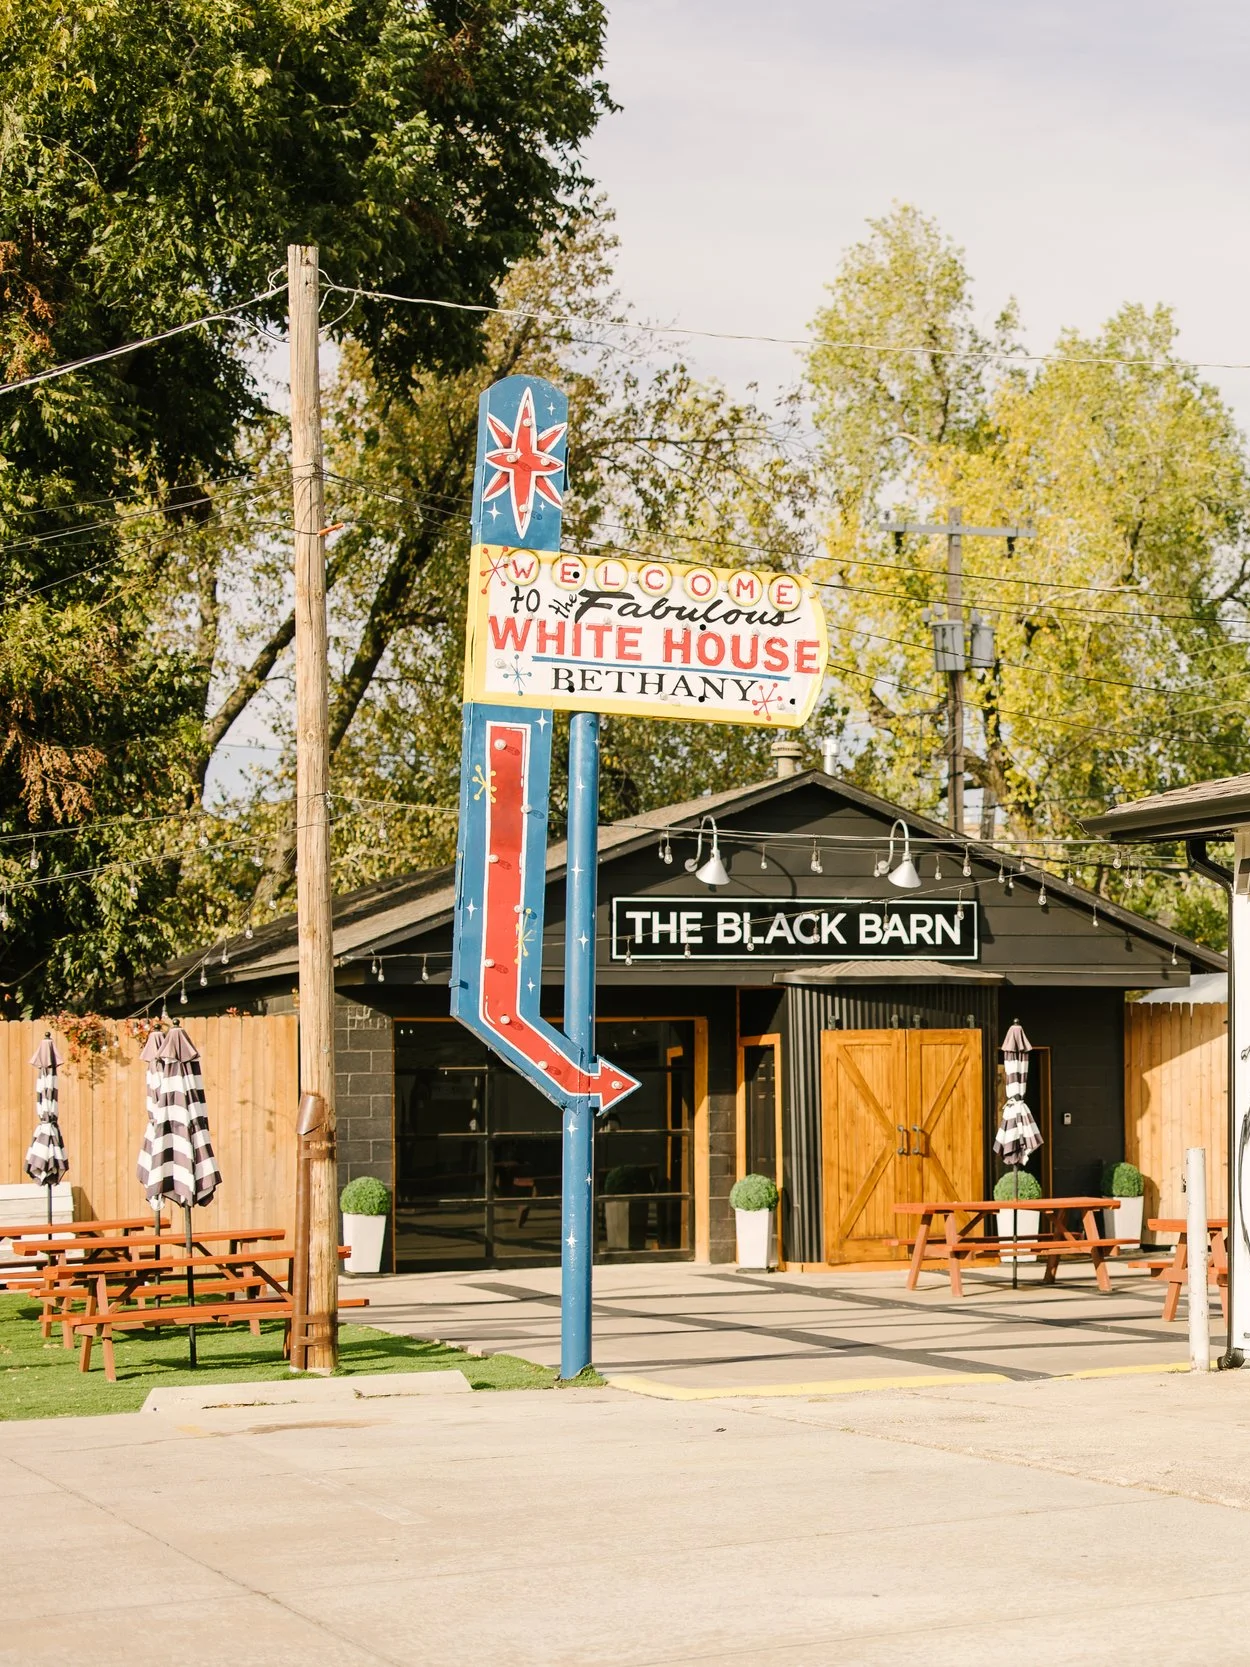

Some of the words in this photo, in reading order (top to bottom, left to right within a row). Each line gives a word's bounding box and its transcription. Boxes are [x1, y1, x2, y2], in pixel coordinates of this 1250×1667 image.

[511, 558, 795, 605] WELCOME
[548, 593, 578, 619] the
[574, 588, 801, 628] Fabulous
[488, 613, 643, 662] WHITE
[662, 627, 821, 675] HOUSE
[551, 666, 759, 702] BETHANY
[625, 910, 704, 945] THE
[716, 911, 848, 945] BLACK
[858, 912, 962, 946] BARN
